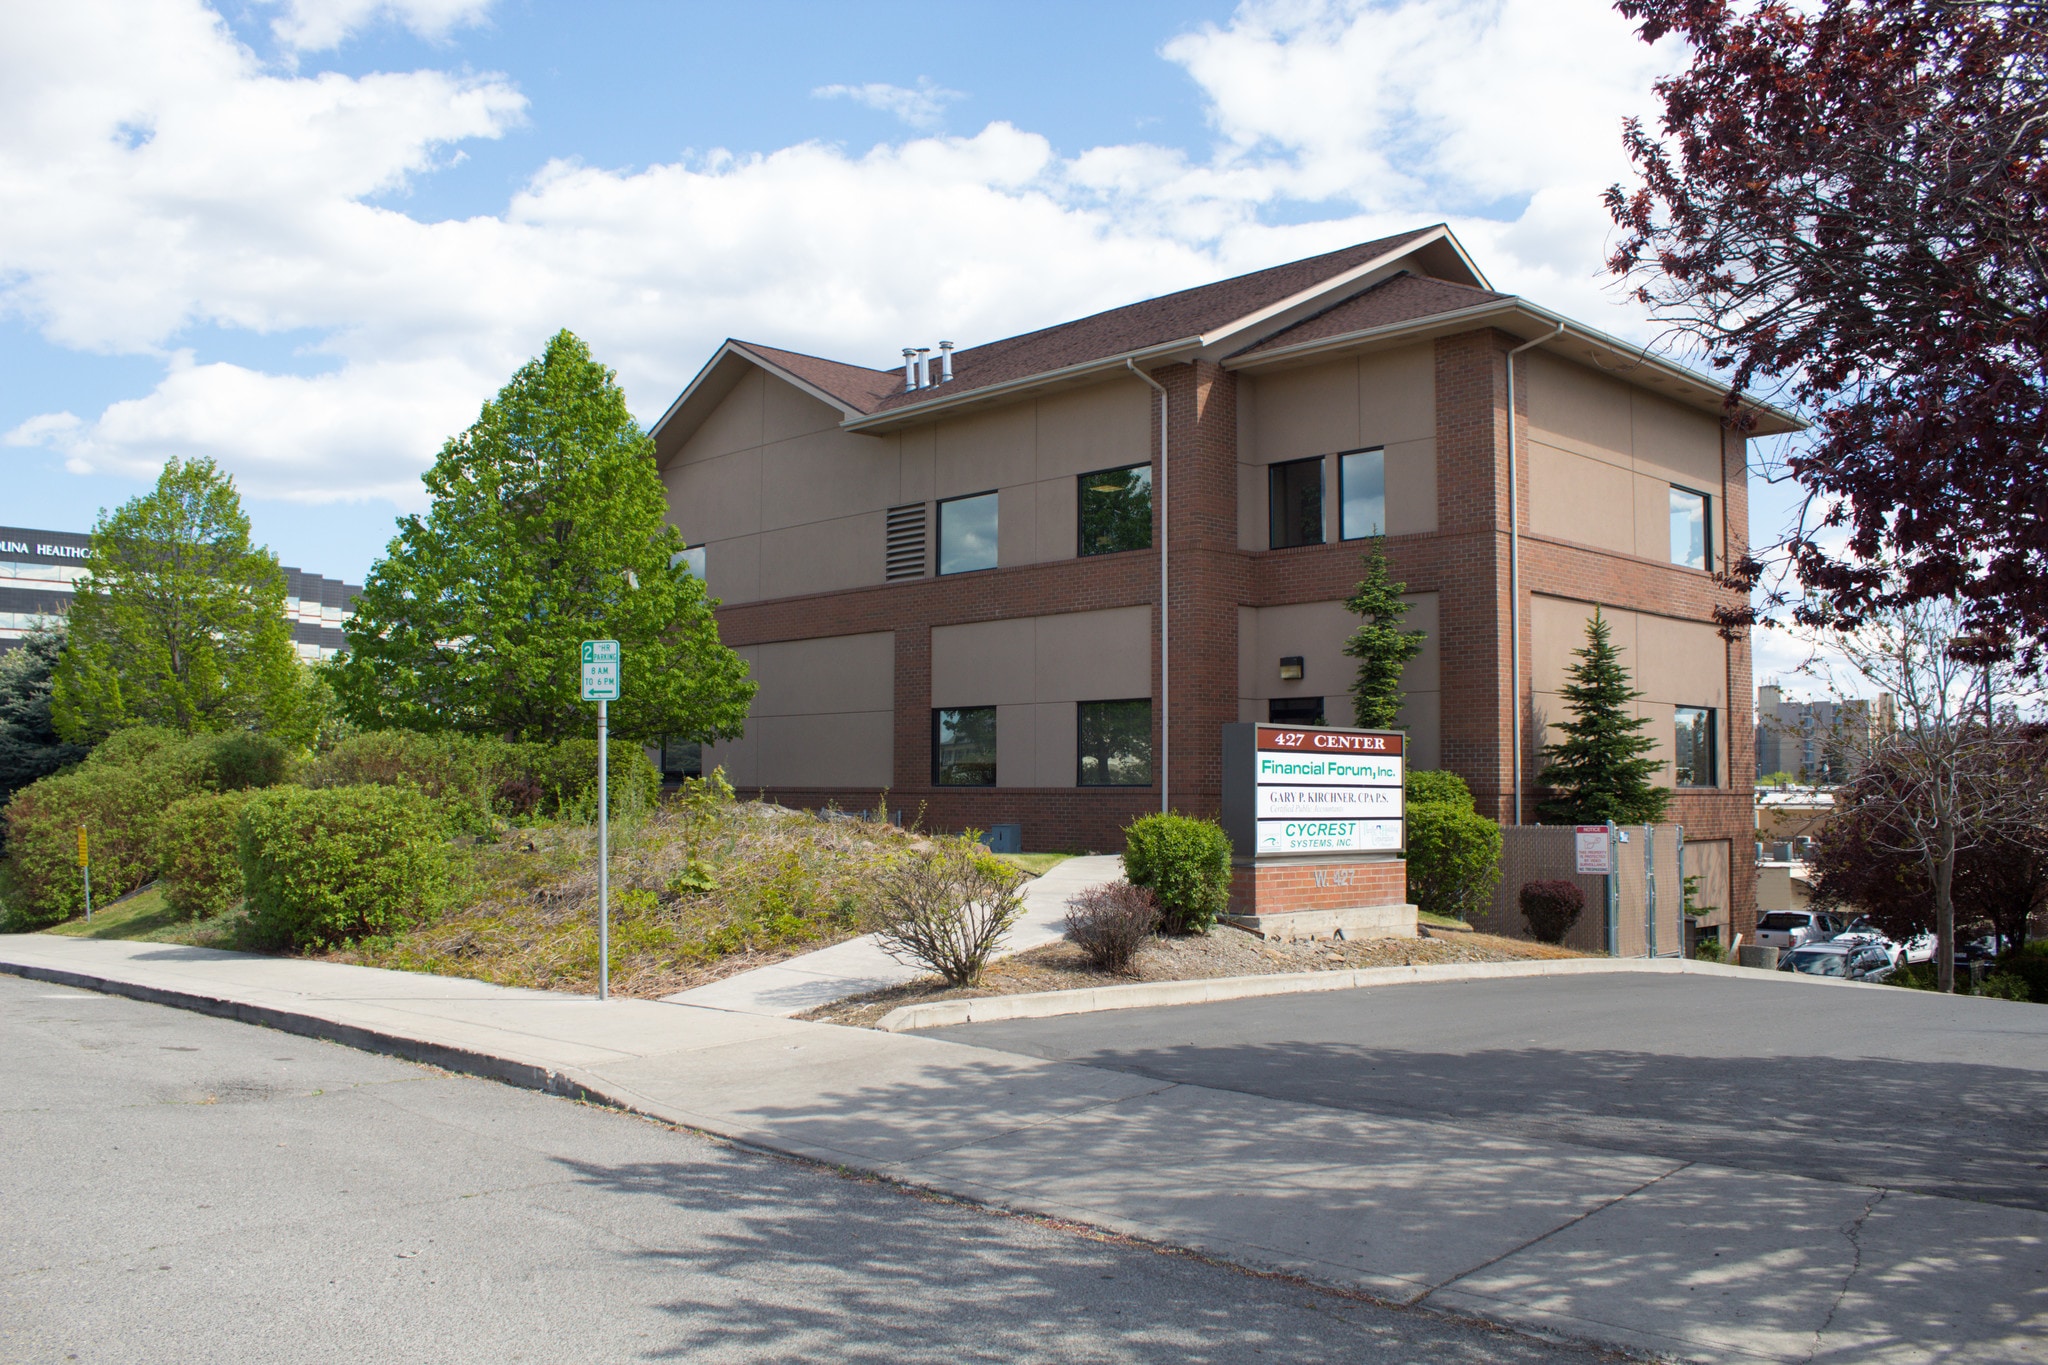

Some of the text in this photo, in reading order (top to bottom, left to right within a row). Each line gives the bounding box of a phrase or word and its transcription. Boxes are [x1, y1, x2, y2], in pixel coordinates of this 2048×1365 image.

[0, 541, 29, 554] LINA
[584, 645, 592, 660] 2
[591, 666, 596, 675] 8
[585, 678, 594, 686] TO
[597, 678, 602, 686] 6
[1275, 733, 1386, 750] 427 CENTER
[1262, 759, 1396, 780] Financial Forum, Inc.
[1270, 792, 1296, 803] GARY
[1299, 792, 1306, 803] P.
[1286, 823, 1356, 837] CYCREST
[1290, 838, 1353, 849] SYSTEMS, INC.
[1314, 869, 1355, 888] W. 427
